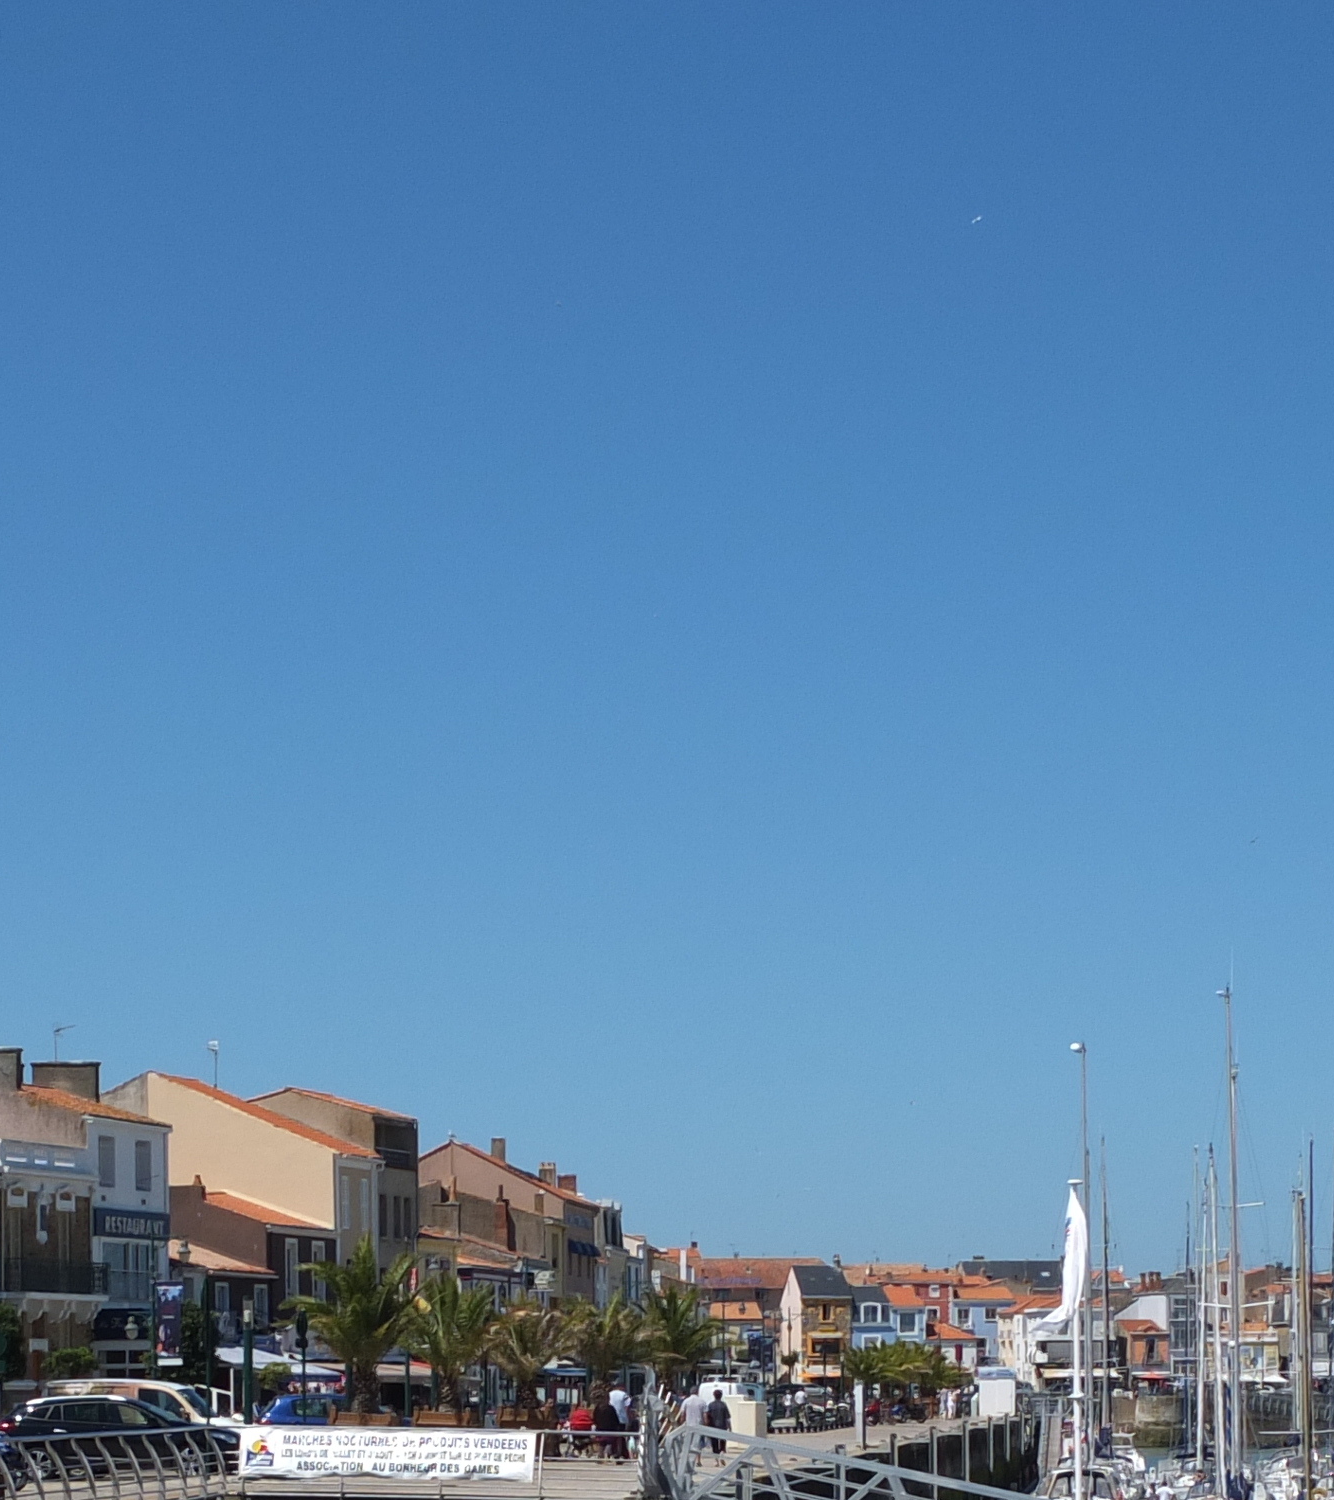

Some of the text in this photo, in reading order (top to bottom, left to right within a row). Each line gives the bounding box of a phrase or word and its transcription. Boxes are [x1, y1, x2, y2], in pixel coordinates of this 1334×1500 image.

[104, 1215, 165, 1236] RESTAURANT
[473, 1437, 528, 1450] VENDEENS
[296, 1460, 364, 1472] ASSOCIATION
[372, 1461, 386, 1472] AU
[388, 1462, 438, 1473] BONHEUR
[440, 1463, 460, 1473] DES
